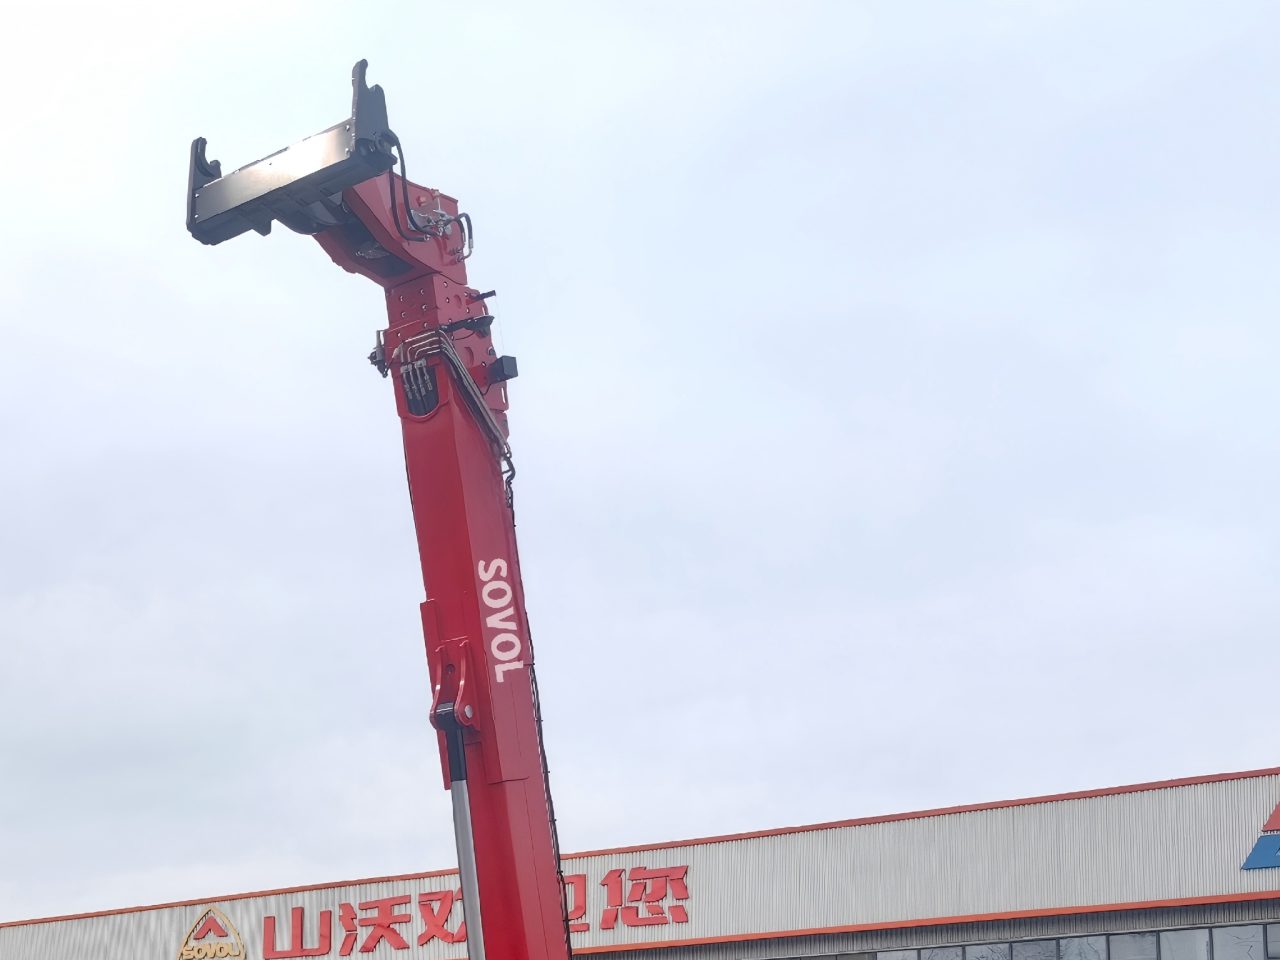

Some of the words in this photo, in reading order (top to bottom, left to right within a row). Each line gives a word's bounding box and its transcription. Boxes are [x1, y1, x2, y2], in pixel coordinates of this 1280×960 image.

[478, 558, 523, 683] SOVOL
[182, 943, 240, 960] SOVOL
[263, 866, 689, 960] 山沃欢您
